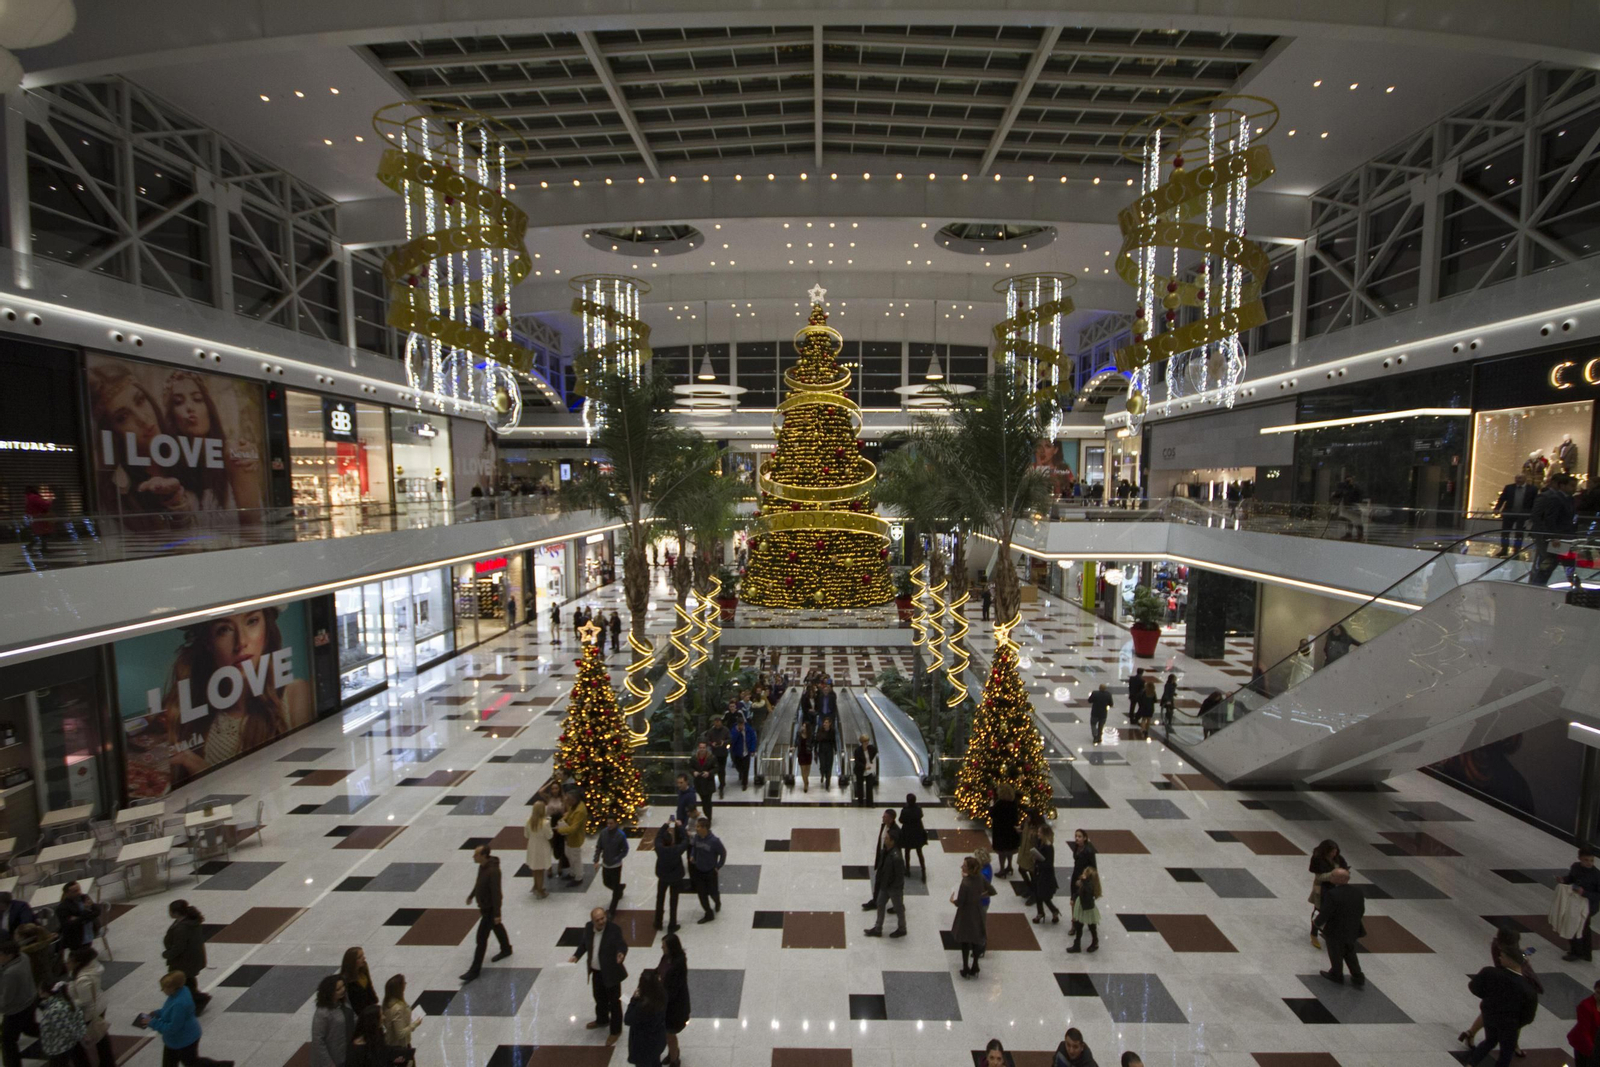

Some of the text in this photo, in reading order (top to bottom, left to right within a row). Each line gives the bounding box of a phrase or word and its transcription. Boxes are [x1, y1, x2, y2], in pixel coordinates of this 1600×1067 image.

[102, 430, 115, 465] I
[126, 431, 224, 469] LOVE
[1162, 447, 1176, 458] COS
[463, 458, 491, 476] LOVE
[178, 647, 294, 725] LOVE
